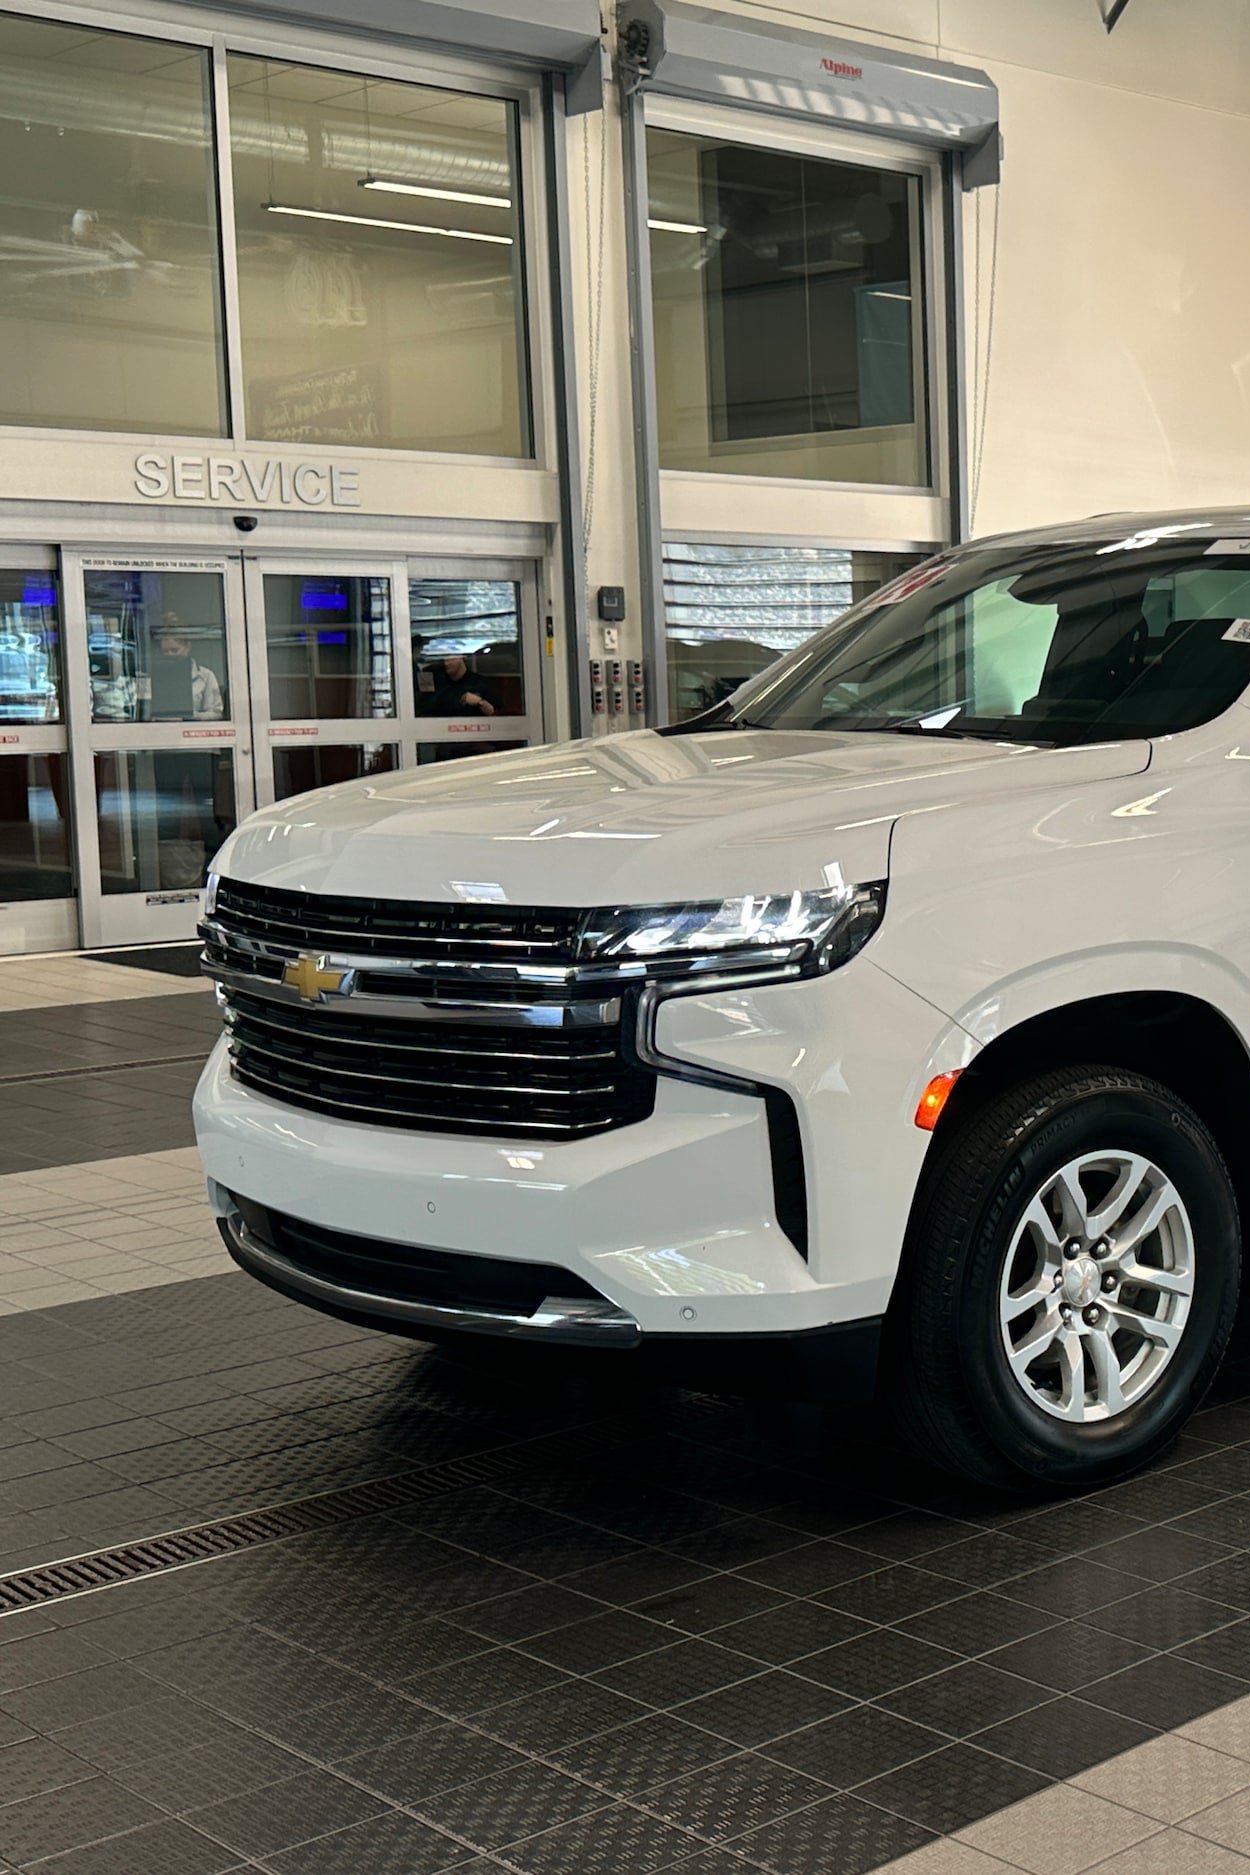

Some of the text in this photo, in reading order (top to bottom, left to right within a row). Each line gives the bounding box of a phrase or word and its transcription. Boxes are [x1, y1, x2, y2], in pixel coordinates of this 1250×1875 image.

[820, 57, 863, 79] Alpine
[134, 453, 361, 508] SERVICE
[971, 1166, 1023, 1288] MICHELIN
